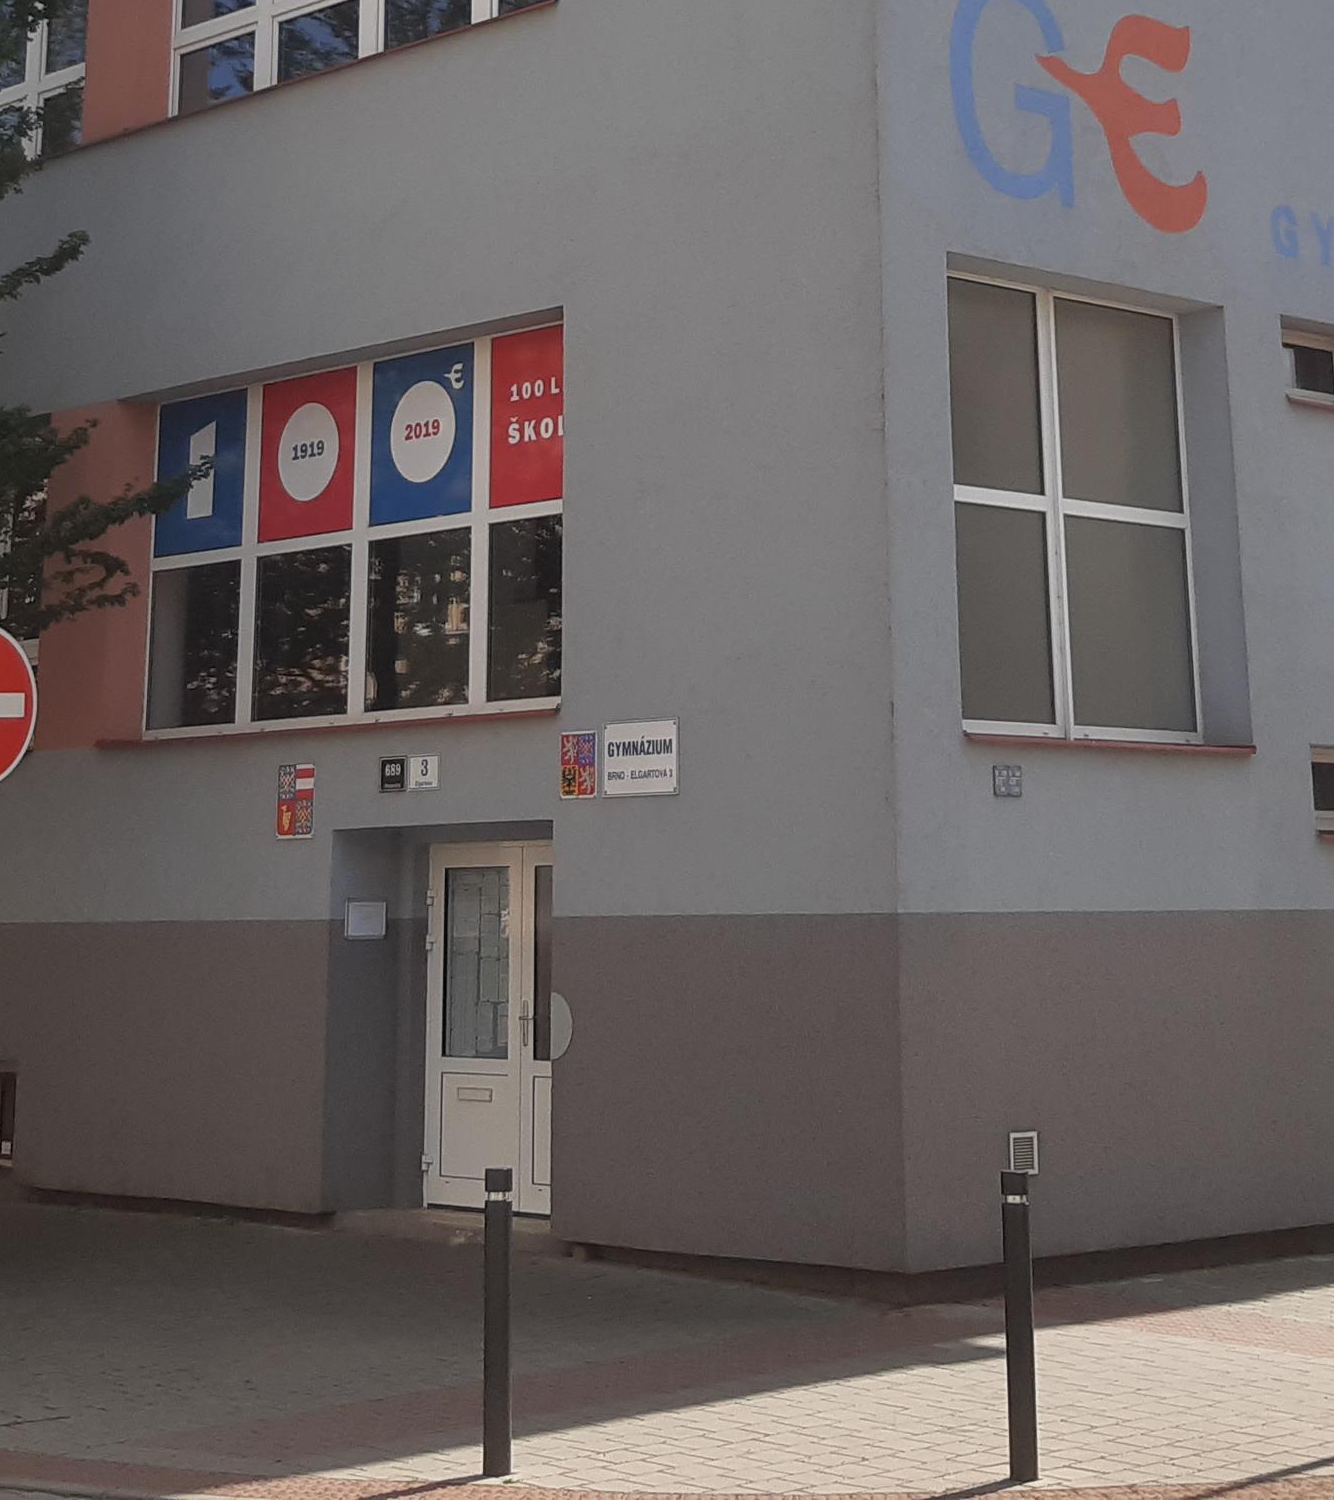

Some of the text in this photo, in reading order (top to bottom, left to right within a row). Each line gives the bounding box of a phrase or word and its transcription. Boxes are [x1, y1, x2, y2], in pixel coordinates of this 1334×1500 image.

[509, 379, 545, 402] 100
[403, 418, 441, 442] 2019
[291, 439, 325, 461] 1919
[607, 735, 673, 758] GYMNÁZIUM
[420, 758, 429, 777] 3
[607, 770, 625, 781] BRNO
[630, 767, 668, 780] ELGARTOVÁ
